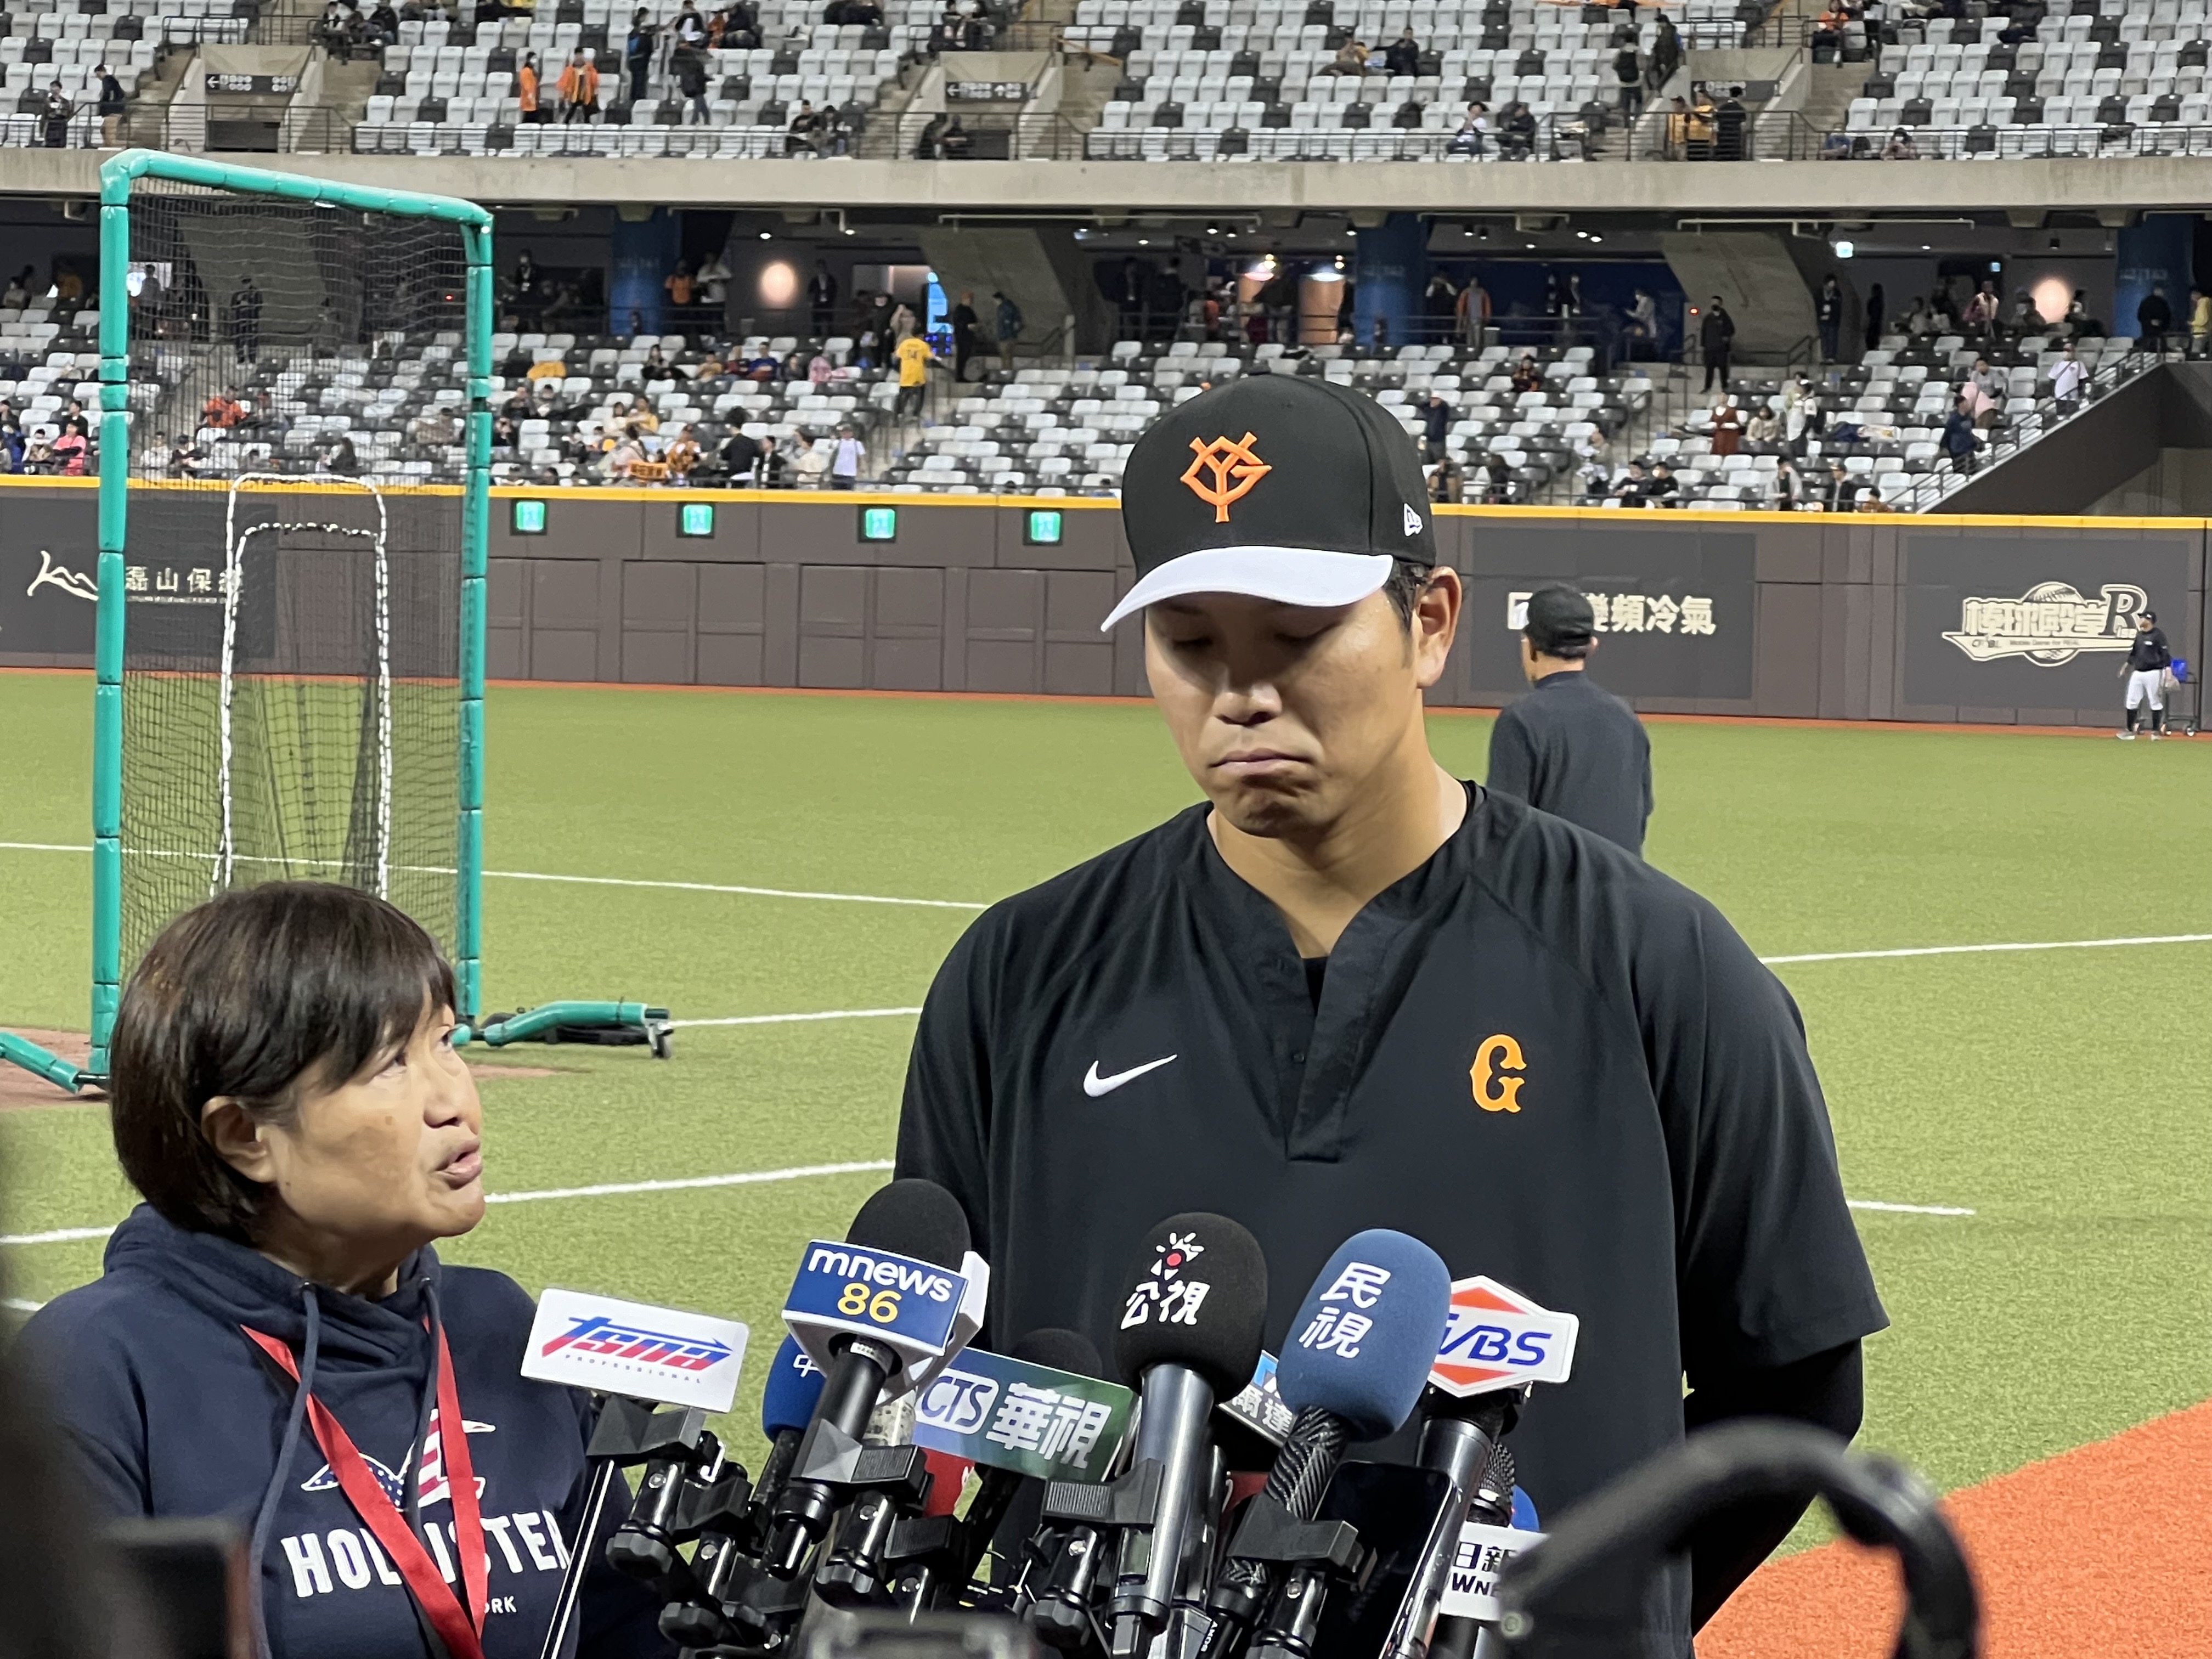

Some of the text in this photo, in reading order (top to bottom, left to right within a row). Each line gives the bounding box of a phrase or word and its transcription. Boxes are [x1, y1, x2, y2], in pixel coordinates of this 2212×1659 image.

[125, 566, 243, 593] 磊山保
[1470, 1033, 1527, 1114] G
[808, 1249, 953, 1302] mnews
[837, 1283, 902, 1324] 86
[1120, 1280, 1210, 1330] 公視
[1299, 1262, 1391, 1359] 民視
[921, 1376, 992, 1427] CTS
[986, 1381, 1112, 1469] 華視
